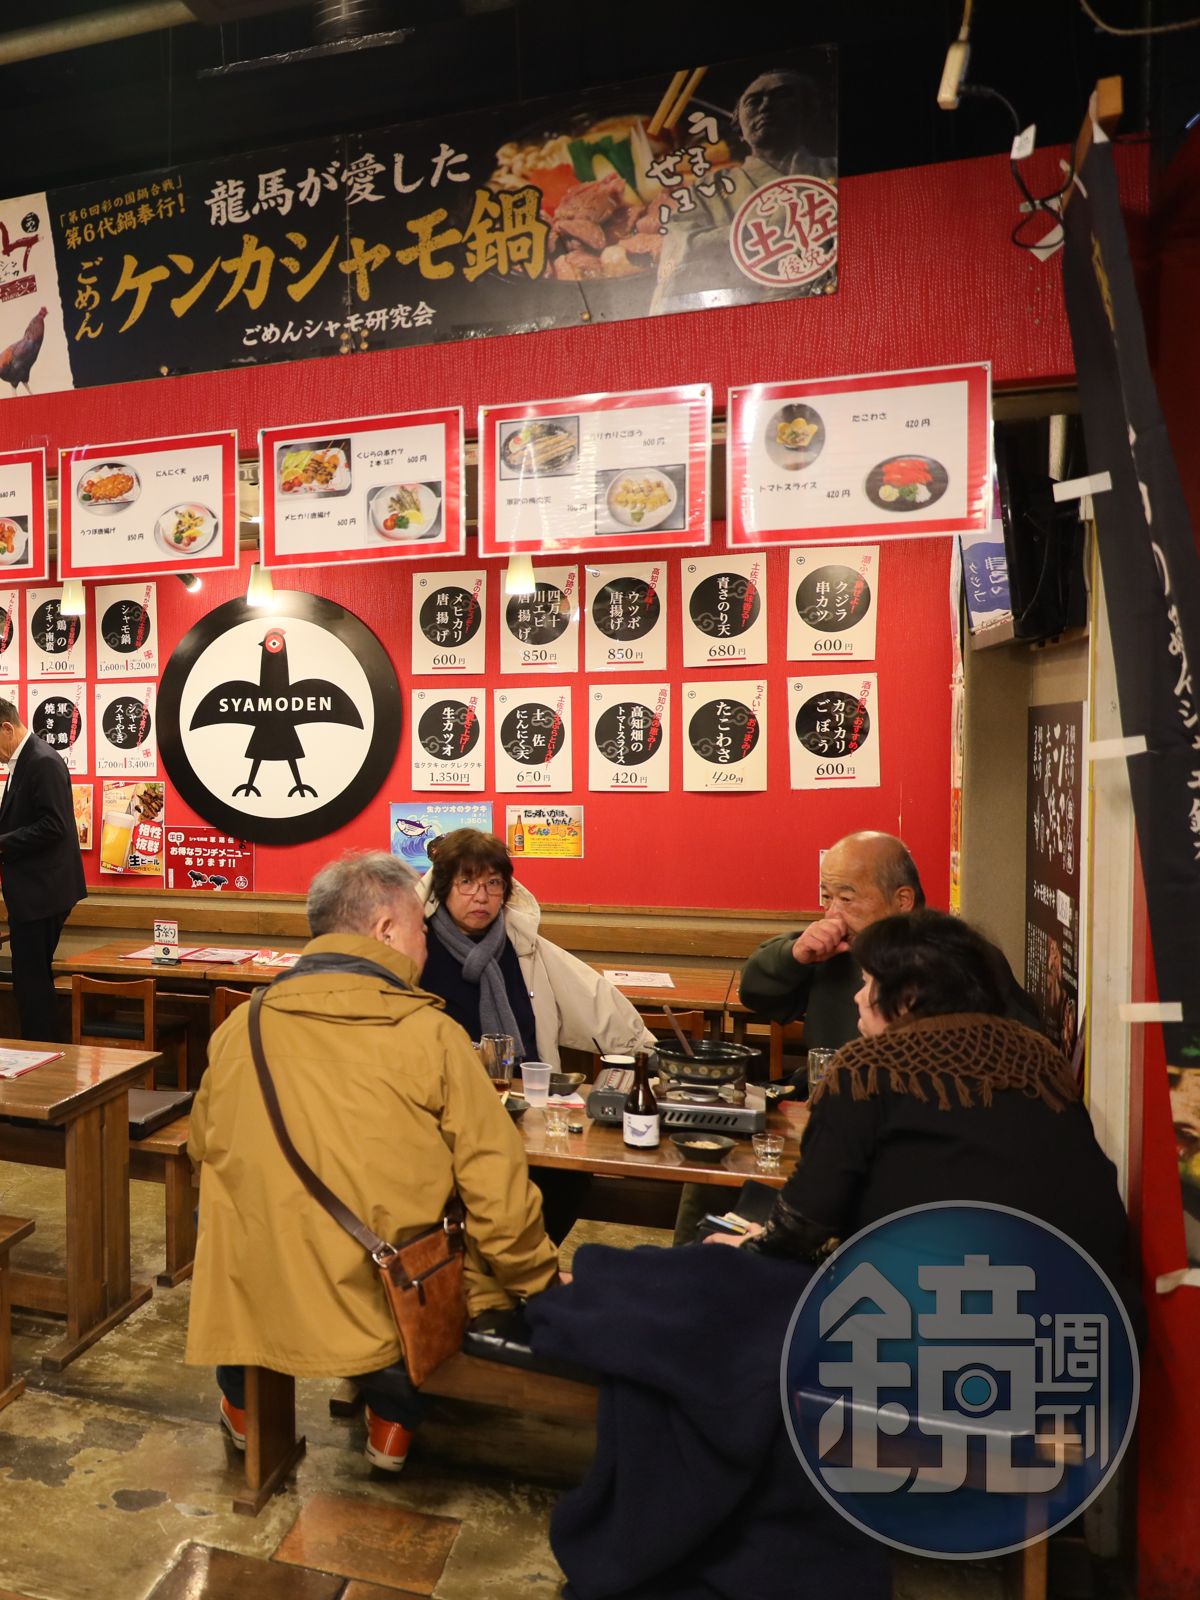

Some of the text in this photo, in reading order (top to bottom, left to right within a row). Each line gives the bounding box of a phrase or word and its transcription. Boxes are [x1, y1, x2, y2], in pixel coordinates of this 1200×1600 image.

[204, 143, 471, 226] 龍馬が愛した
[64, 193, 186, 250] 第6代鍋奉行!
[745, 191, 838, 271] 土佐
[111, 186, 548, 334] ケンカシャモ鍋
[74, 256, 104, 341] ごめん
[242, 301, 437, 346] ごめんシャモ研究会
[436, 593, 449, 643] 唐揚げ
[453, 593, 463, 643] メヒカリ
[533, 590, 545, 628] 川エビ
[547, 590, 561, 628] 四万十
[609, 591, 624, 631] 唐揚げ
[627, 591, 640, 630] ウツボ
[717, 576, 731, 636] 青さのり天
[815, 581, 830, 621] 串カツ
[835, 580, 849, 621] クジラ
[56, 604, 68, 647] 鶏の
[120, 605, 131, 645] シャモ鍋
[813, 638, 853, 651] 600円
[433, 654, 465, 665] 600円
[523, 650, 557, 661] 850円
[608, 648, 643, 659] 850円
[708, 644, 746, 657] 680円
[114, 704, 124, 744] スキやき
[128, 703, 137, 733] シャモ
[219, 697, 332, 712] SYAMODEN
[442, 707, 455, 756] 生カツオ
[516, 710, 529, 760] にんにく天
[532, 709, 546, 747] 土佐
[616, 706, 626, 764] トマトスライス
[631, 706, 644, 752] 高知畑の
[716, 702, 732, 763] たこわさ
[815, 699, 831, 753] ごぼう
[832, 699, 846, 754] カリカリ
[612, 772, 648, 784] 420円
[816, 762, 856, 775] 600円
[135, 837, 160, 853] 抜群
[138, 823, 162, 840] 相性
[129, 855, 160, 867] 生ビール
[170, 847, 252, 858] お得なランチメニュー
[185, 857, 236, 868] あります!!
[155, 924, 176, 938] 予約
